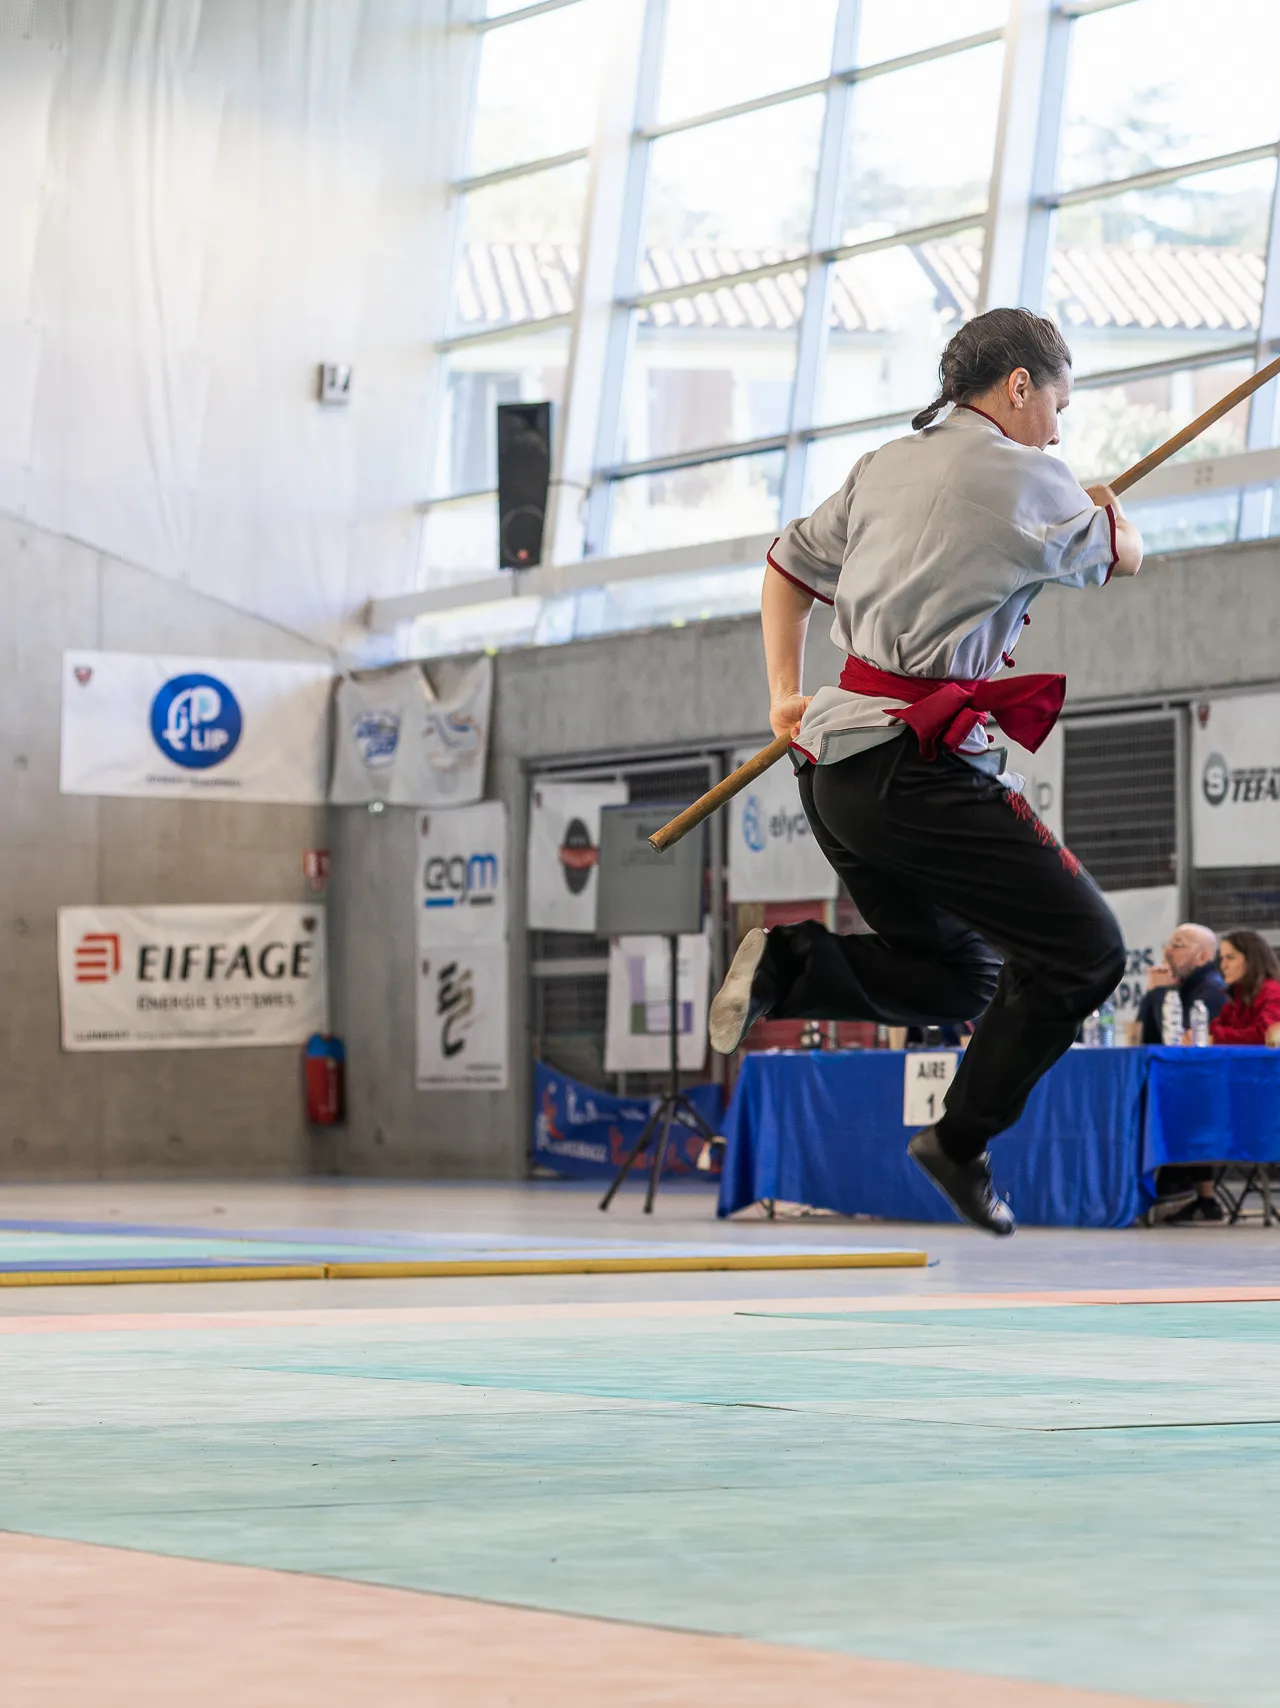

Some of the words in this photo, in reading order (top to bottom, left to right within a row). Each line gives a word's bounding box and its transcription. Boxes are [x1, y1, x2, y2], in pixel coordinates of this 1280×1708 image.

[137, 941, 312, 982] EIFFAGE
[917, 1062, 946, 1079] AIRE
[926, 1093, 936, 1119] 1
